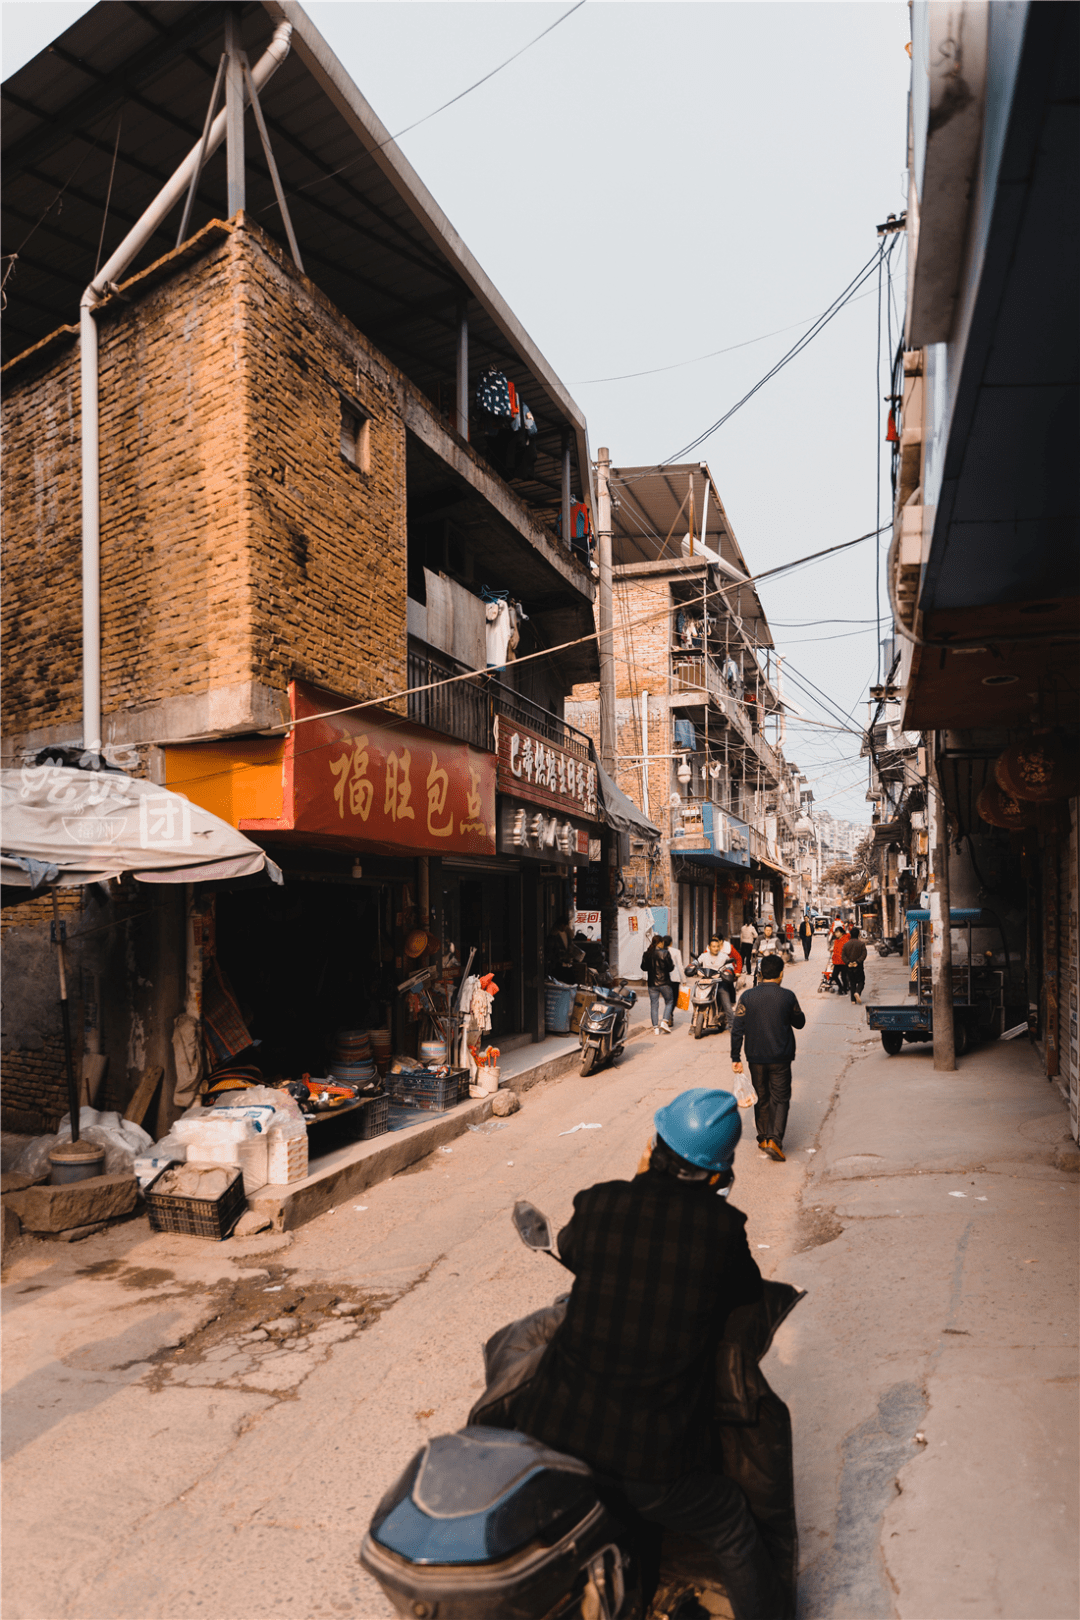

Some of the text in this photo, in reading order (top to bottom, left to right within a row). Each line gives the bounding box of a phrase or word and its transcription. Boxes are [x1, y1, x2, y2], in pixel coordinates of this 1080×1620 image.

[329, 728, 486, 837] 福旺包点
[575, 912, 602, 923] 爱回
